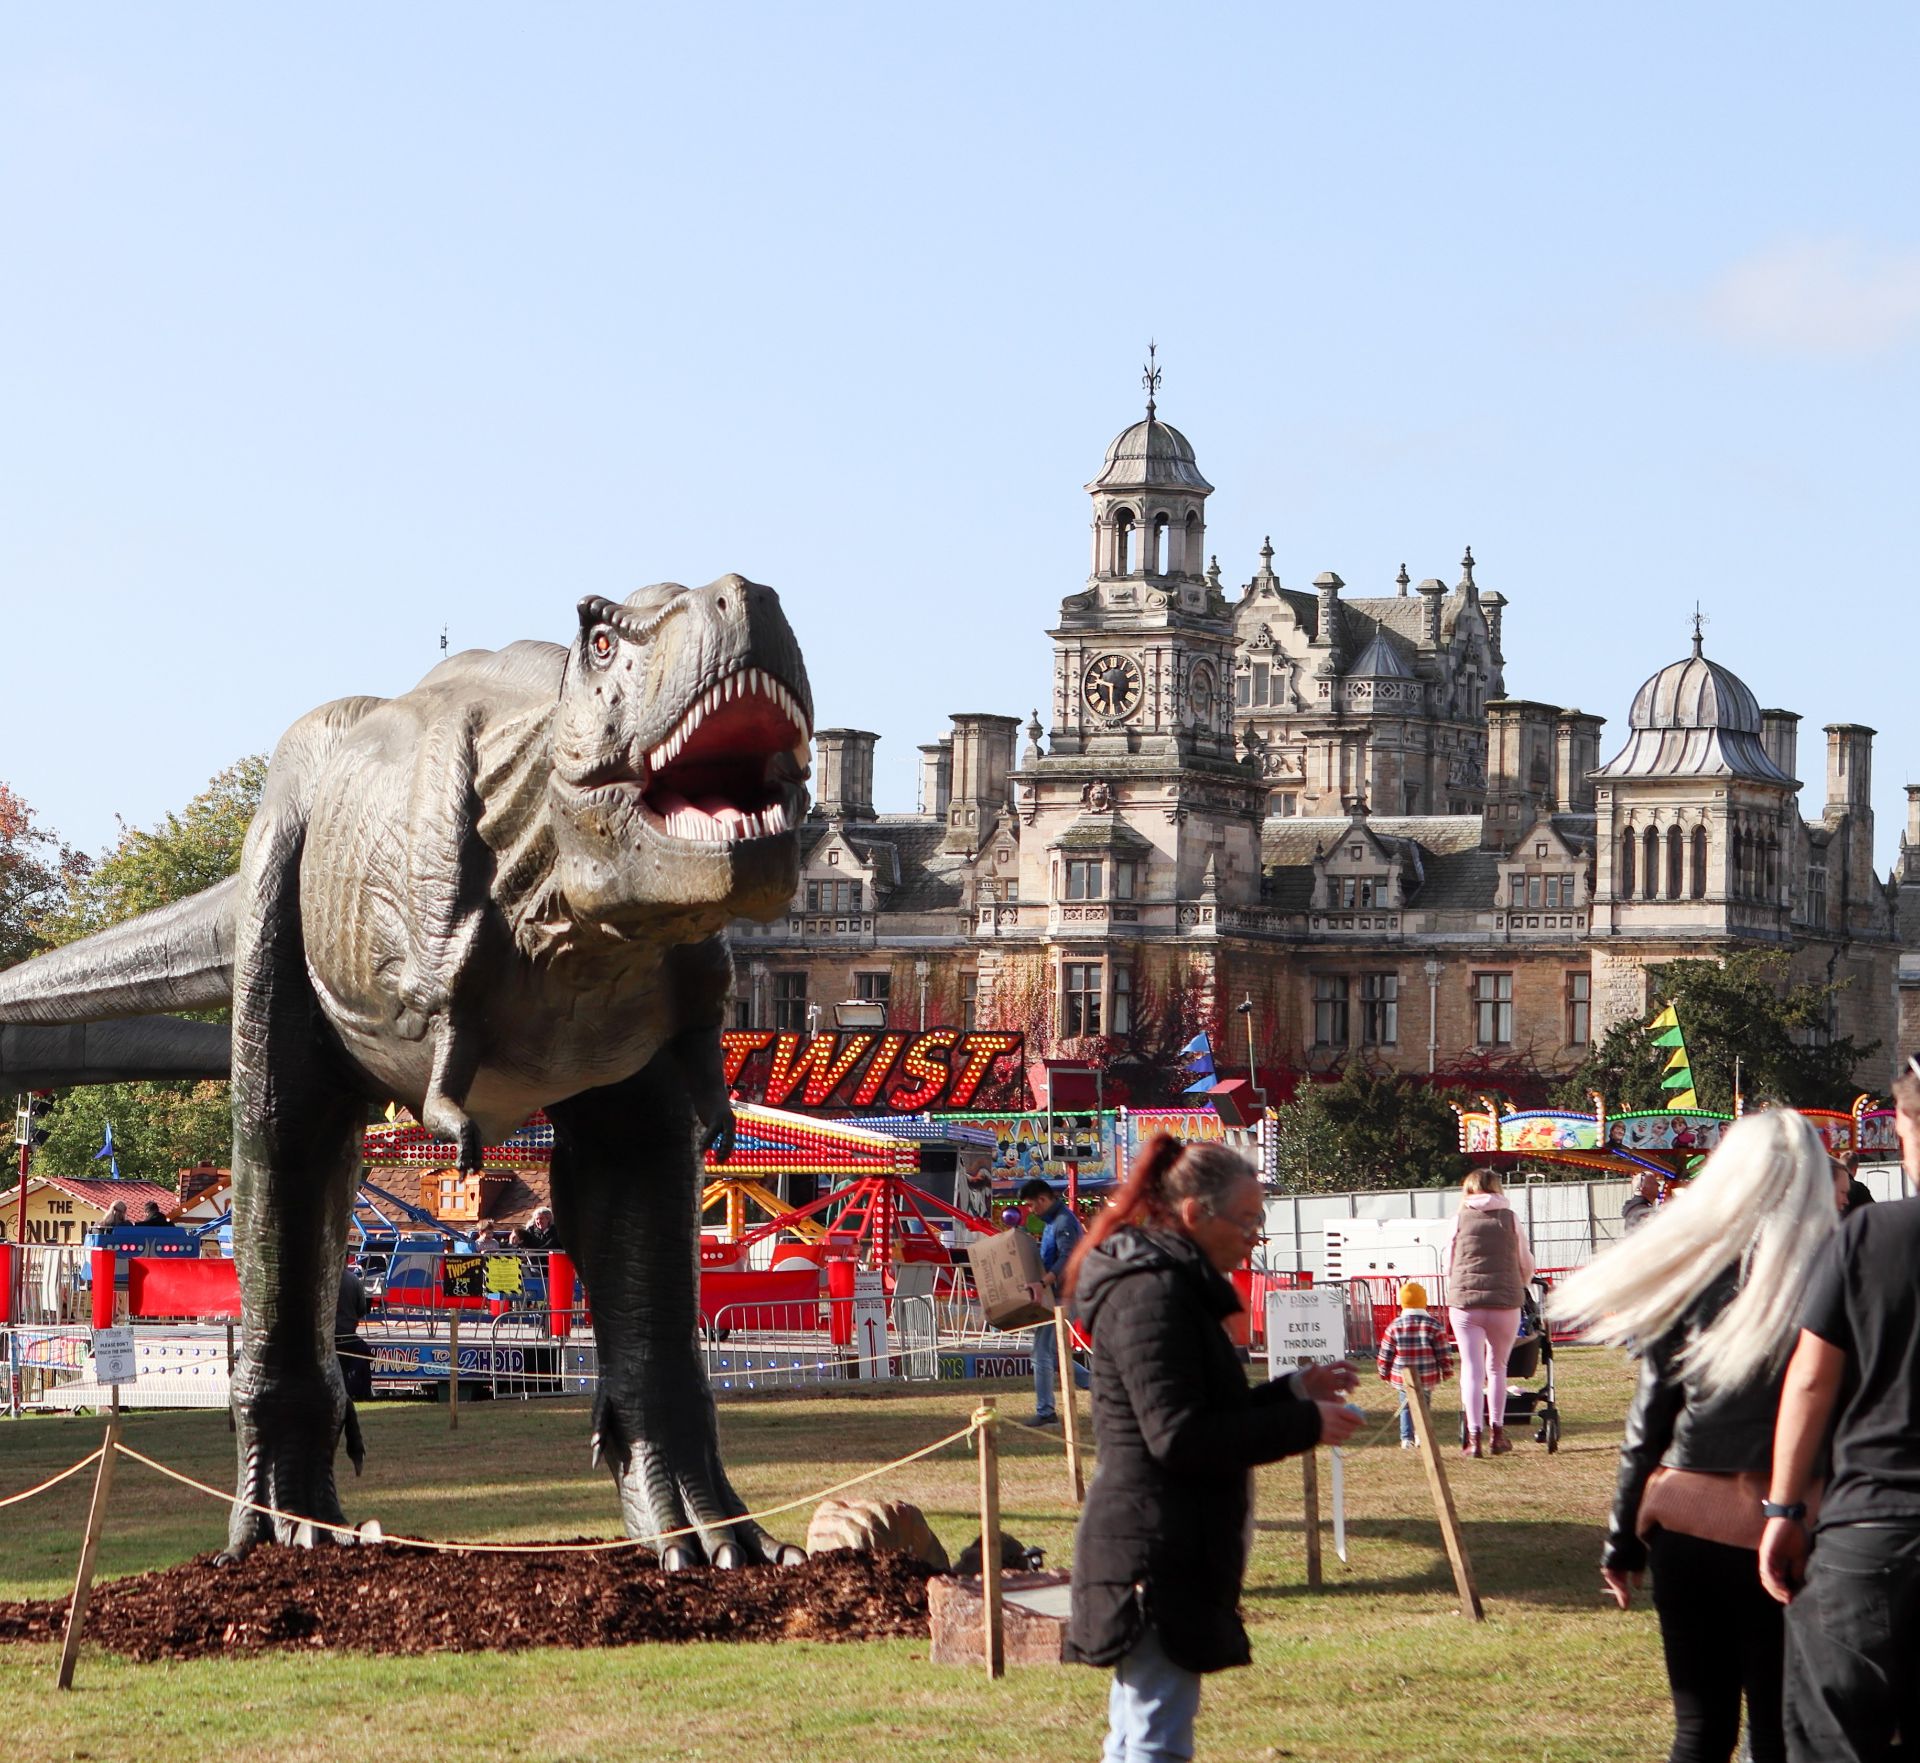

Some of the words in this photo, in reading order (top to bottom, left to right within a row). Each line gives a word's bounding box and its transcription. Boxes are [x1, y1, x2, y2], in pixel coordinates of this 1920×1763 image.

[720, 1026, 1022, 1111] TWIST
[1137, 1115, 1185, 1142] HOOK
[1186, 1115, 1201, 1140] A
[47, 1200, 73, 1214] THE
[447, 1258, 481, 1279] TWISTER
[1288, 1322, 1309, 1333] EXIT
[1311, 1322, 1320, 1332] IS
[1283, 1338, 1327, 1349] THROUGH
[370, 1347, 420, 1374] HANDLE
[458, 1349, 477, 1375] 2
[476, 1350, 524, 1374] HOLD
